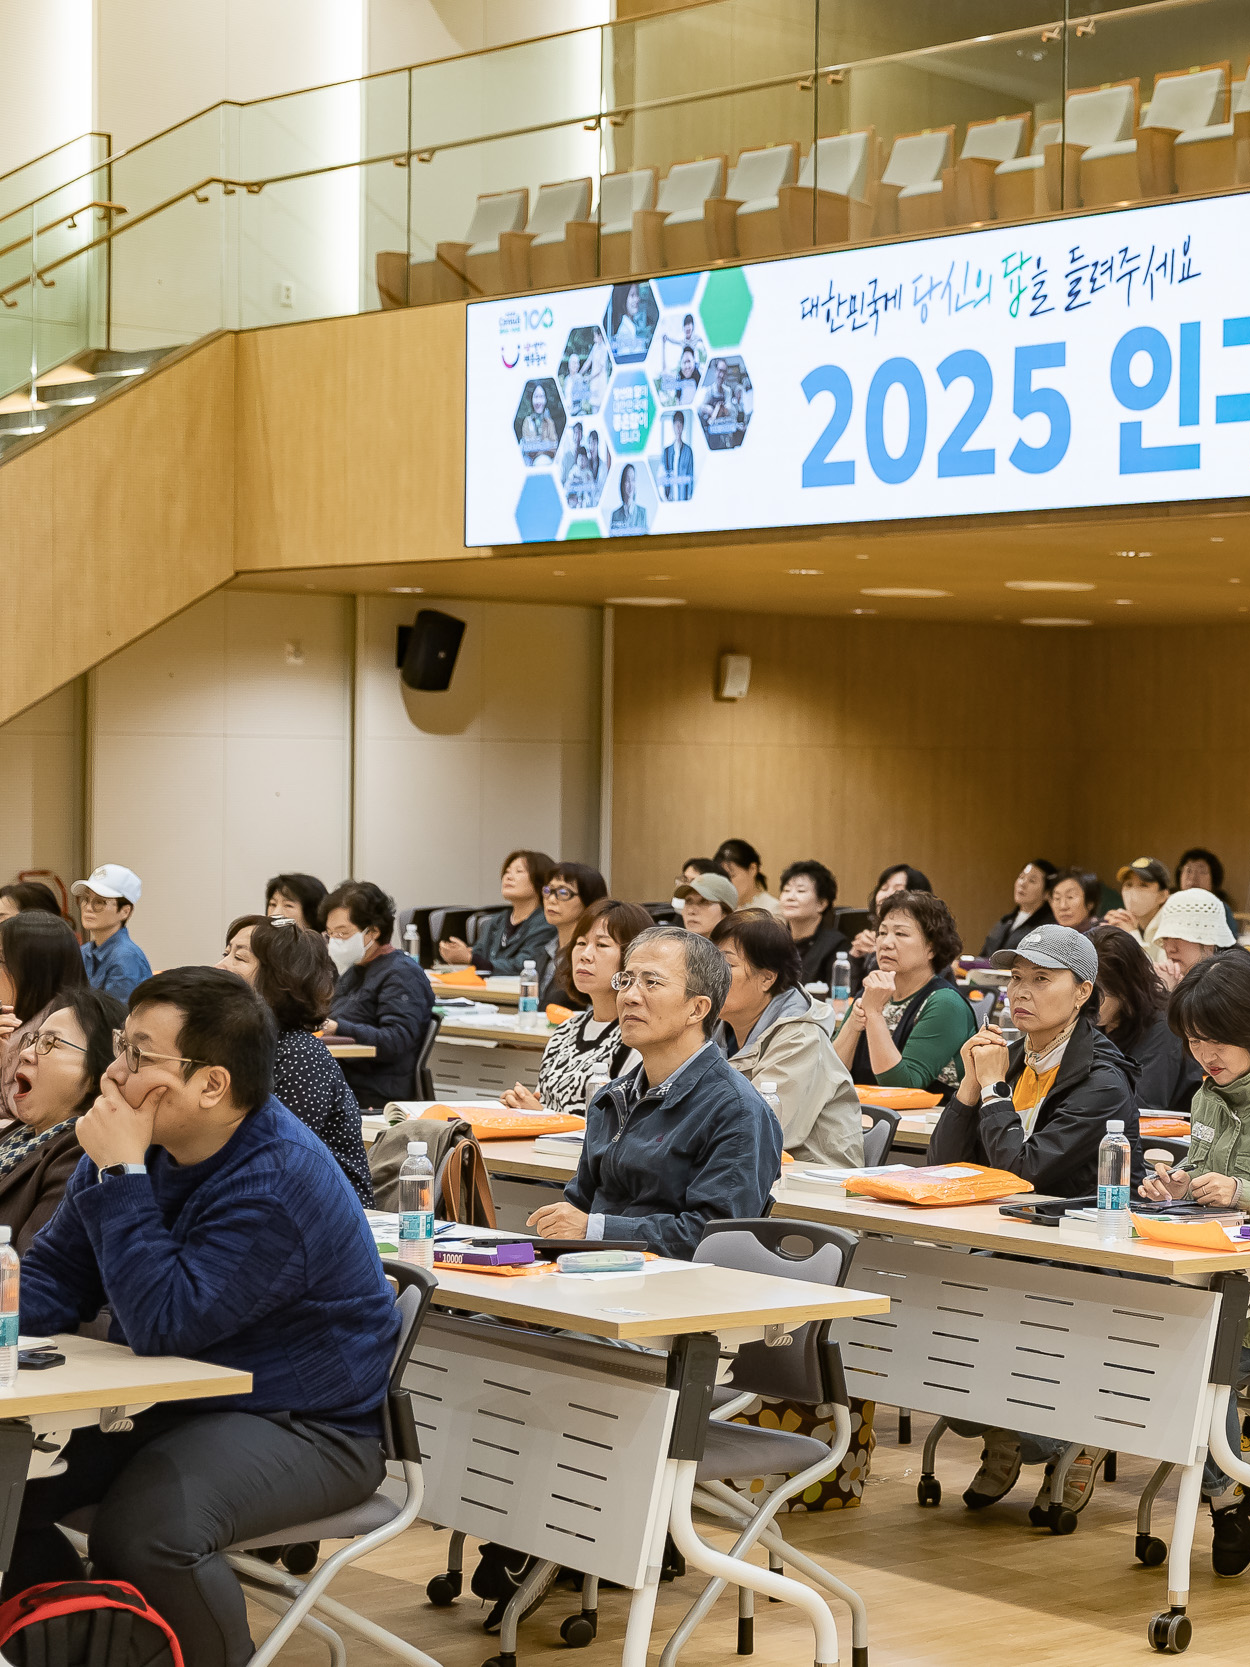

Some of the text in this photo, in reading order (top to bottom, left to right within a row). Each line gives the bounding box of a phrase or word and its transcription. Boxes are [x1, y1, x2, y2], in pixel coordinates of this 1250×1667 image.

[800, 235, 1202, 336] 대한민국에 당신의 답을 들려주세요
[801, 341, 1071, 488] 2025
[442, 1253, 464, 1264] 10000
